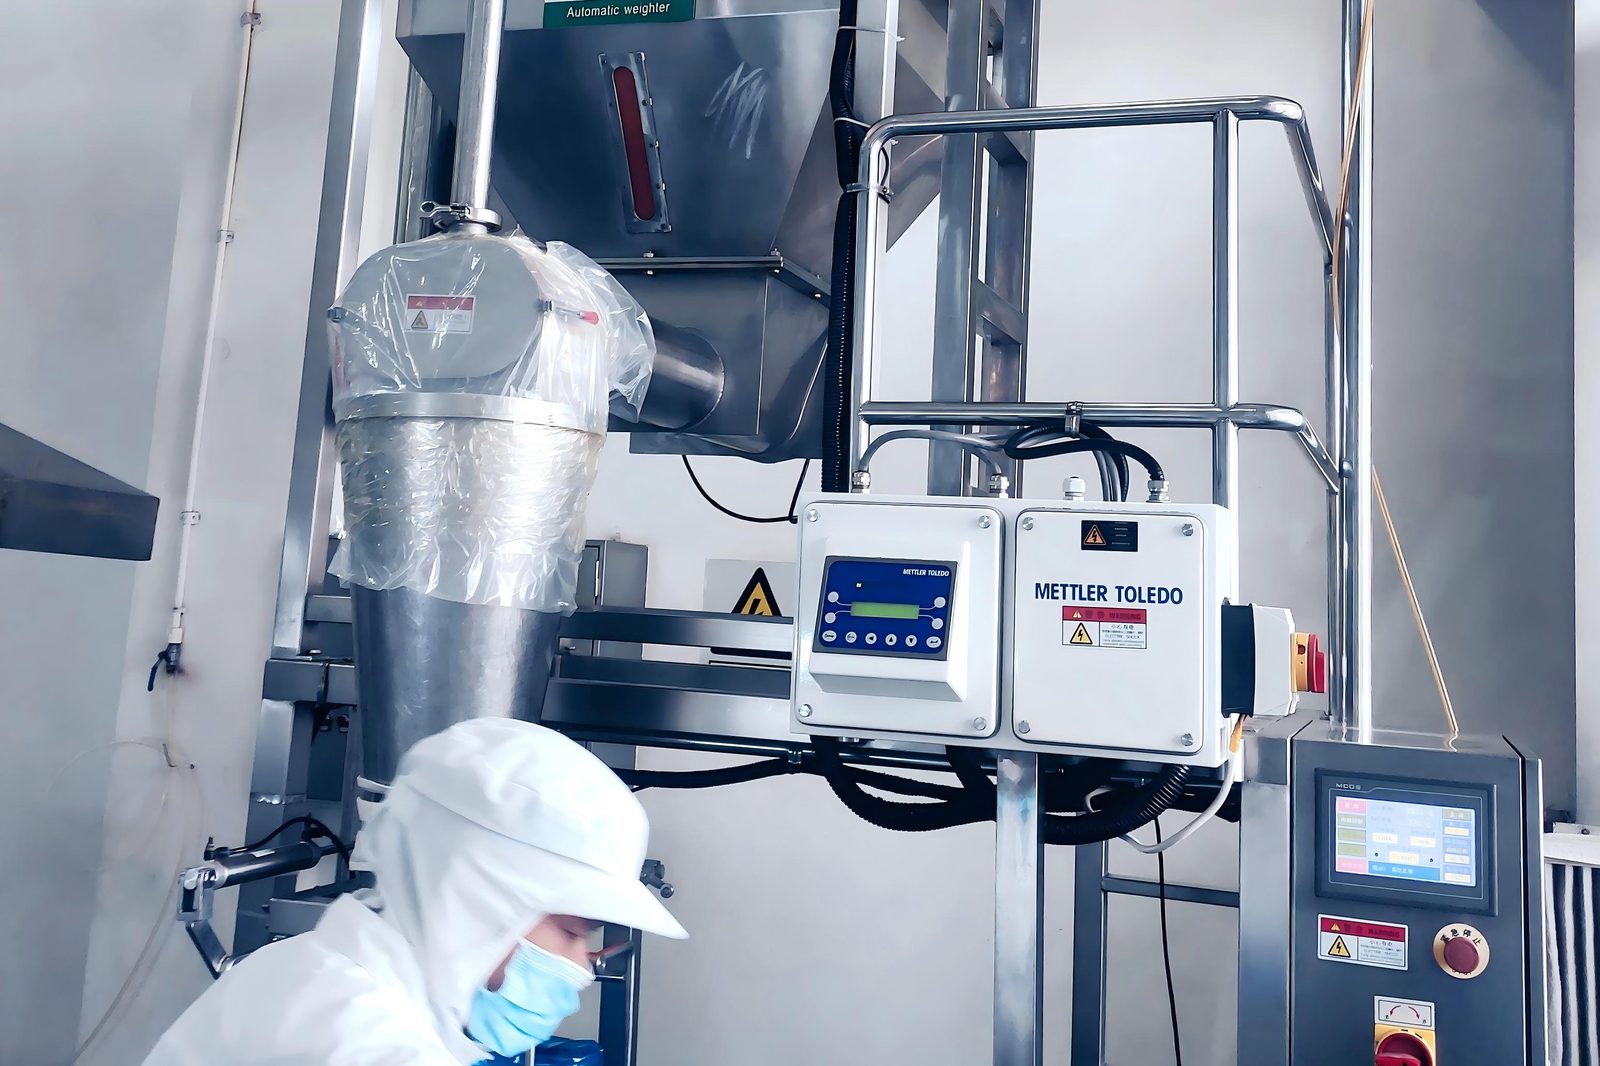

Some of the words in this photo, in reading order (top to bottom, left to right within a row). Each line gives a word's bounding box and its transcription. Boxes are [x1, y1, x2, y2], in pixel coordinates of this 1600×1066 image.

[566, 5, 620, 18] Automatic
[624, 3, 671, 16] weighter
[903, 568, 927, 576] METTLER
[928, 569, 950, 577] TOLEDO
[1034, 582, 1108, 602] METTLER
[1115, 585, 1183, 605] TOLEDO
